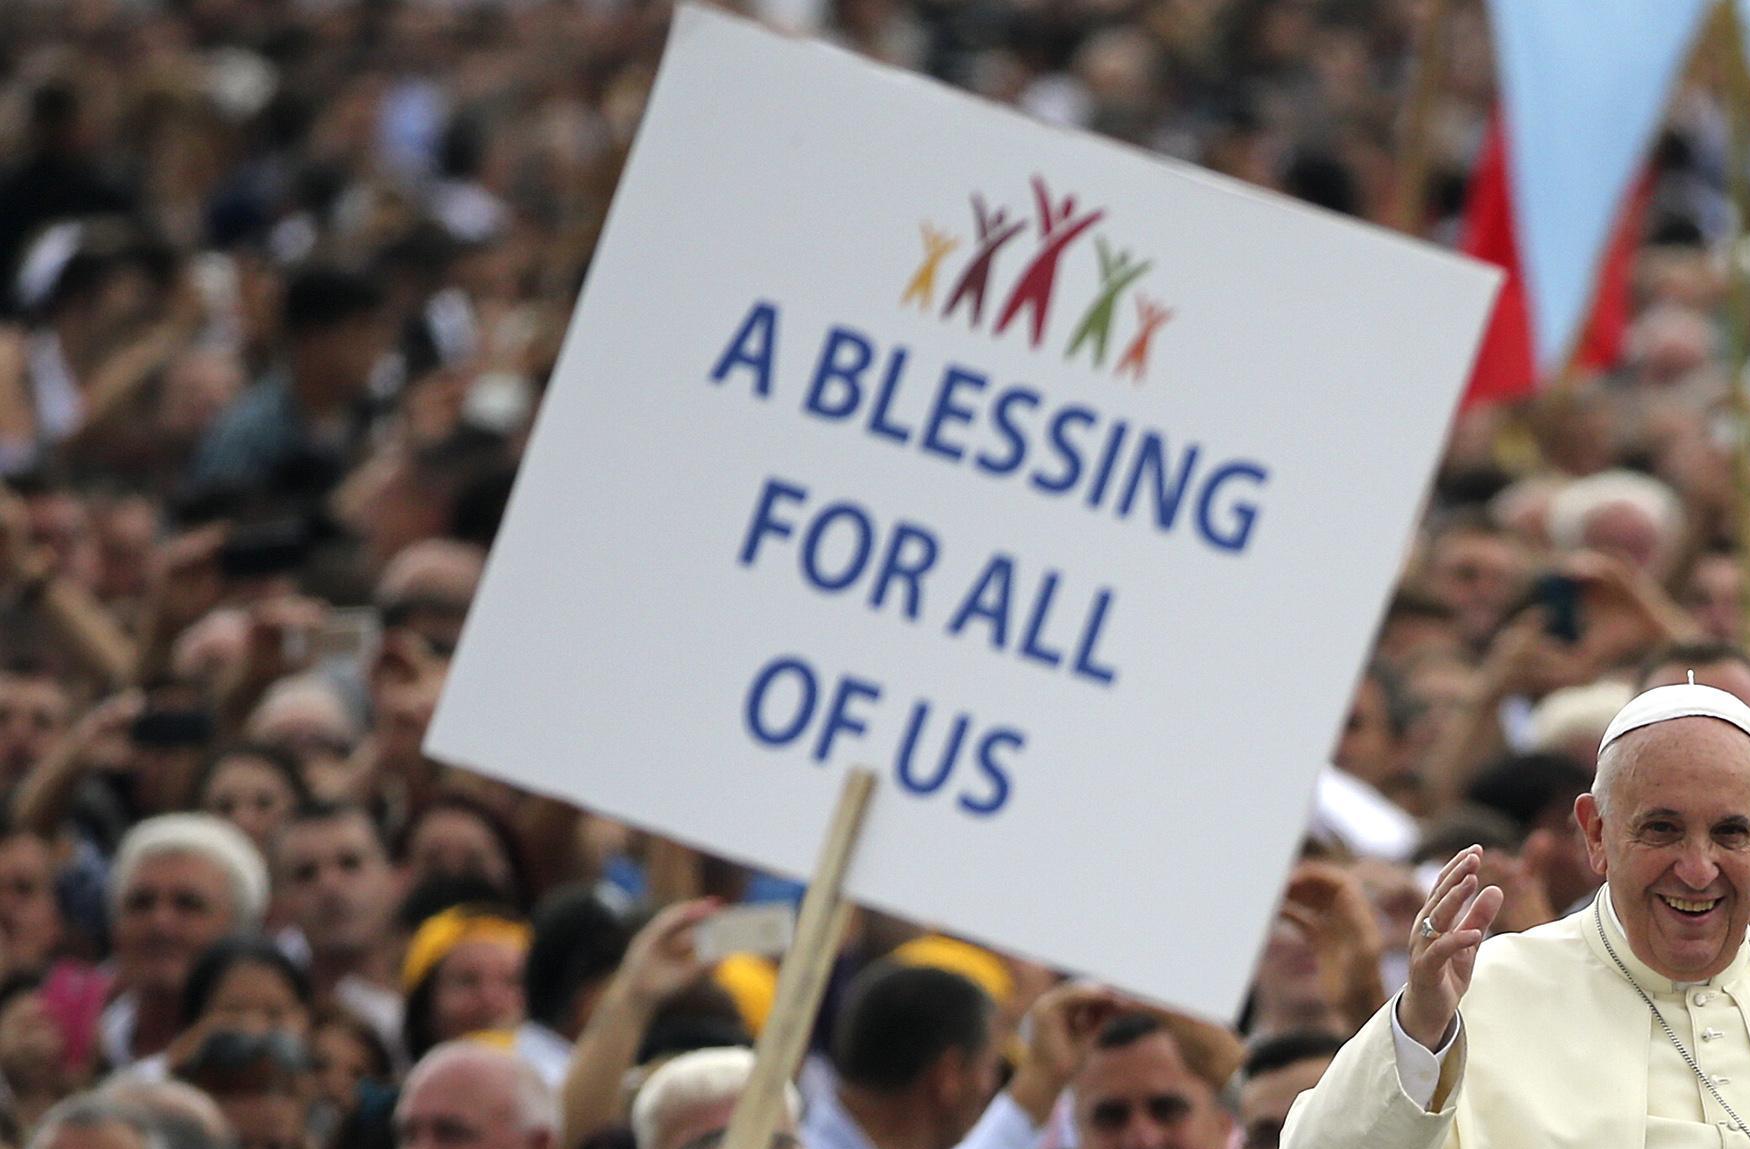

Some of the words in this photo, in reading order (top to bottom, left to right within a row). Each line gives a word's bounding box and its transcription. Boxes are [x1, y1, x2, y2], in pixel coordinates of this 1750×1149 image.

[709, 301, 780, 399] A
[804, 327, 1269, 553] BLESSING
[740, 479, 940, 621] FOR
[949, 554, 1116, 685] ALL
[746, 657, 881, 763] OF
[895, 703, 1025, 817] US
